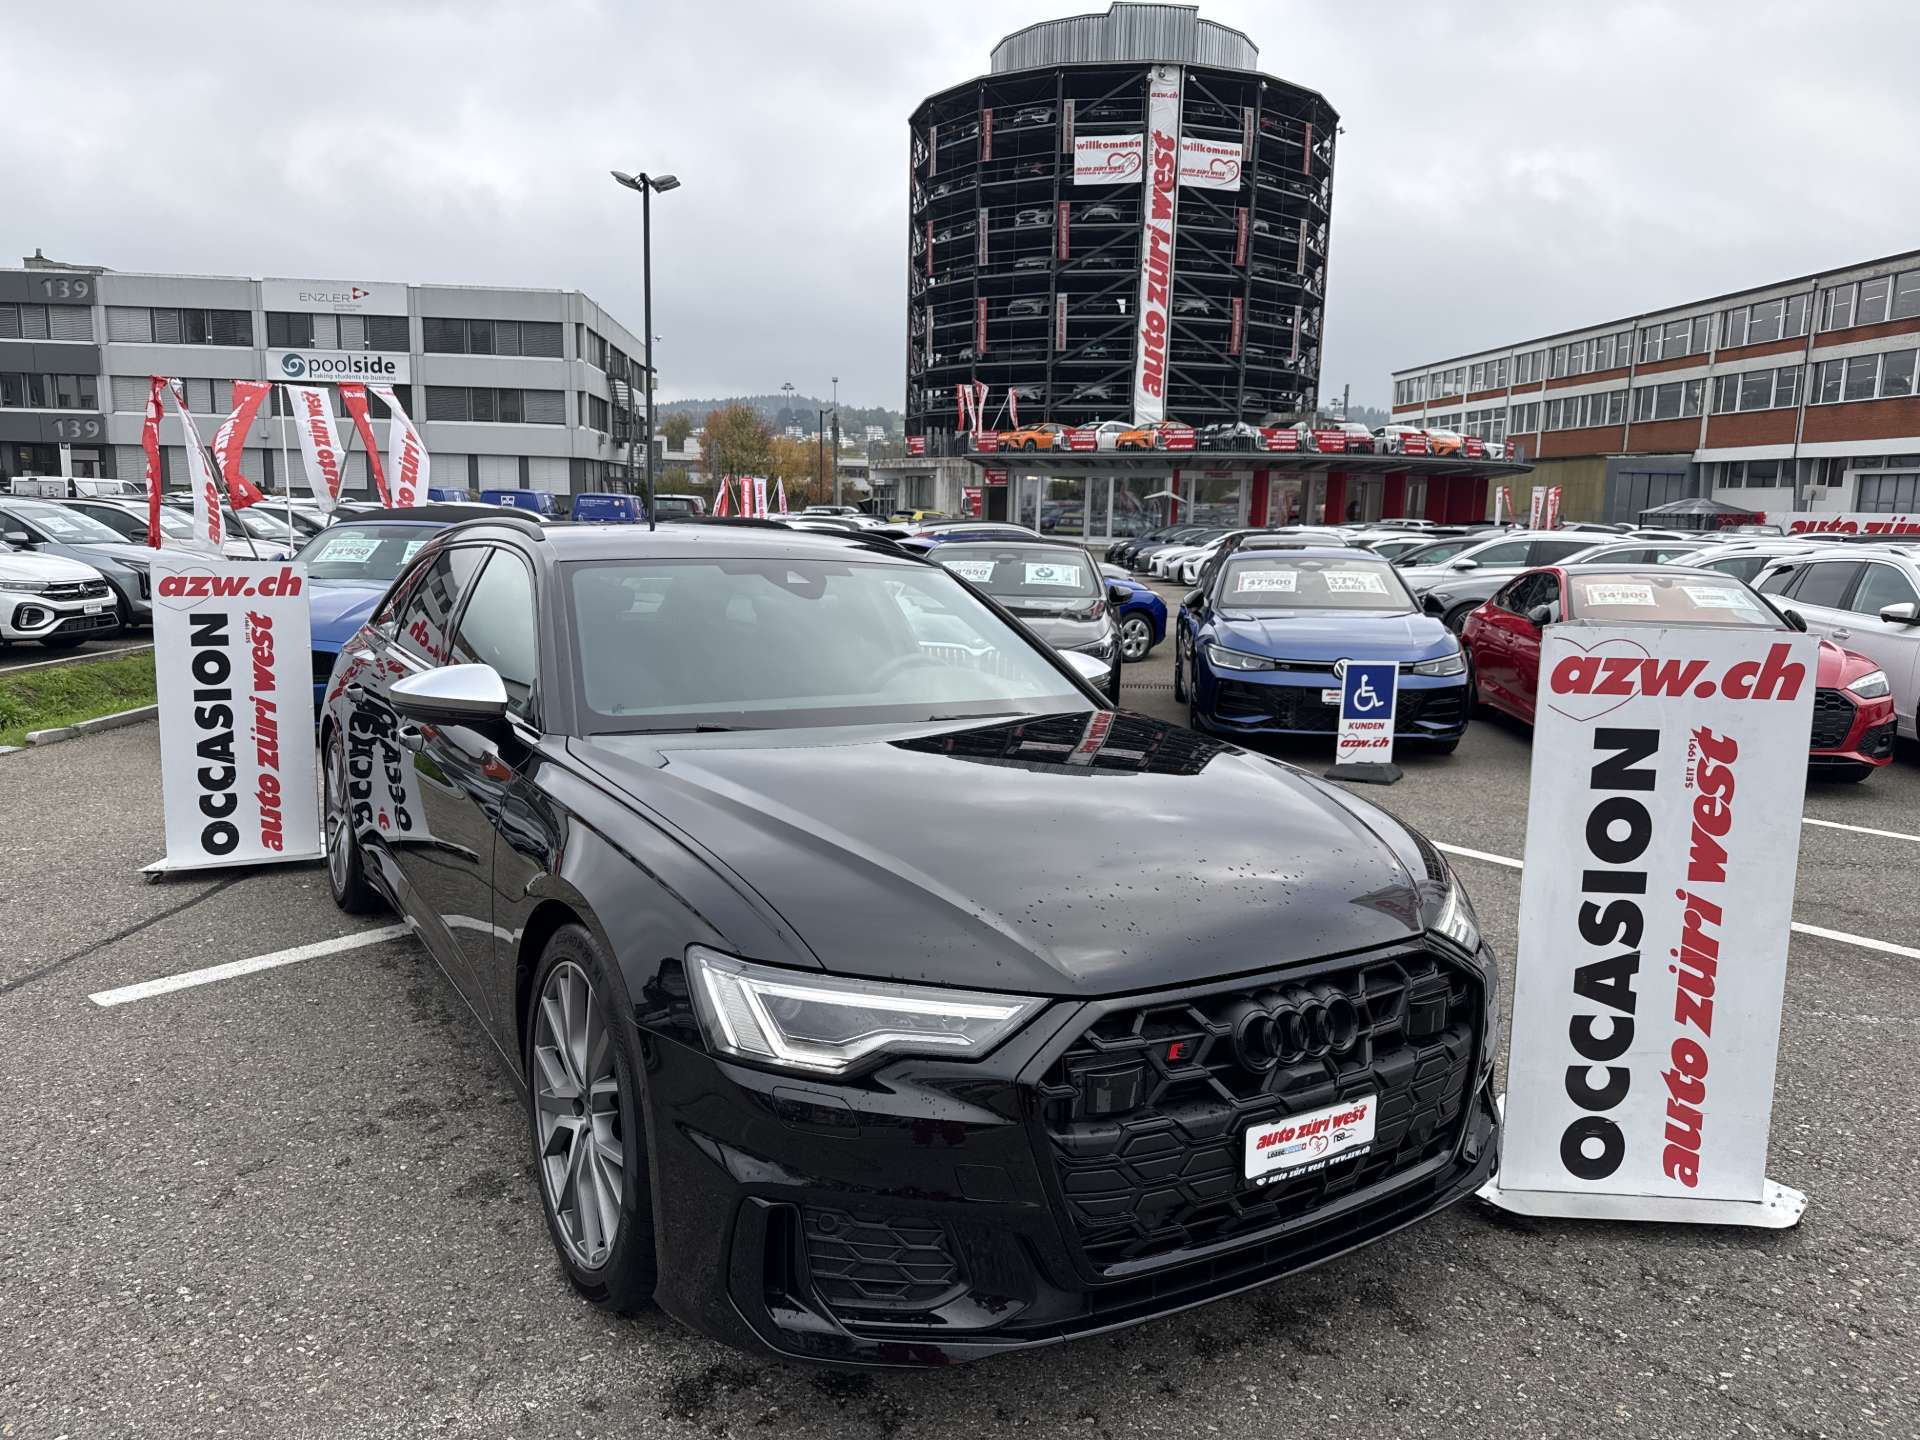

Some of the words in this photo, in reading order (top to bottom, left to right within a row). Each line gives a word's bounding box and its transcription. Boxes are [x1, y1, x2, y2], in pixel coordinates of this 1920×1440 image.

[1076, 139, 1142, 151] willkommen
[1182, 142, 1241, 157] willkommen
[1152, 129, 1176, 220] west
[41, 278, 89, 298] 139
[1144, 224, 1171, 309] züri
[299, 291, 351, 302] ENZLER
[309, 355, 396, 378] poolside
[1141, 310, 1166, 398] auto
[52, 418, 99, 438] 139
[204, 482, 221, 544] auto
[158, 566, 302, 597] azw.ch
[245, 610, 276, 691] west
[1550, 643, 1806, 701] azw.ch
[189, 613, 240, 856] OCCASION
[248, 695, 279, 772] züri
[1340, 737, 1390, 748] azw.ch
[1347, 722, 1385, 730] KUNDEN
[1687, 738, 1698, 764] 1991
[1685, 767, 1695, 789] SEIT
[1687, 725, 1739, 883] west
[254, 773, 284, 852] auto
[1560, 727, 1660, 1180] OCCASION
[1668, 888, 1724, 1038] züri
[1256, 1127, 1296, 1150] auto
[1296, 1115, 1332, 1139] züri
[1332, 1104, 1368, 1129] west
[1661, 1037, 1709, 1188] auto
[1268, 1173, 1288, 1184] auto
[1288, 1166, 1307, 1178] züri
[1307, 1161, 1327, 1173] west
[1329, 1145, 1371, 1166] www.azw.ch
